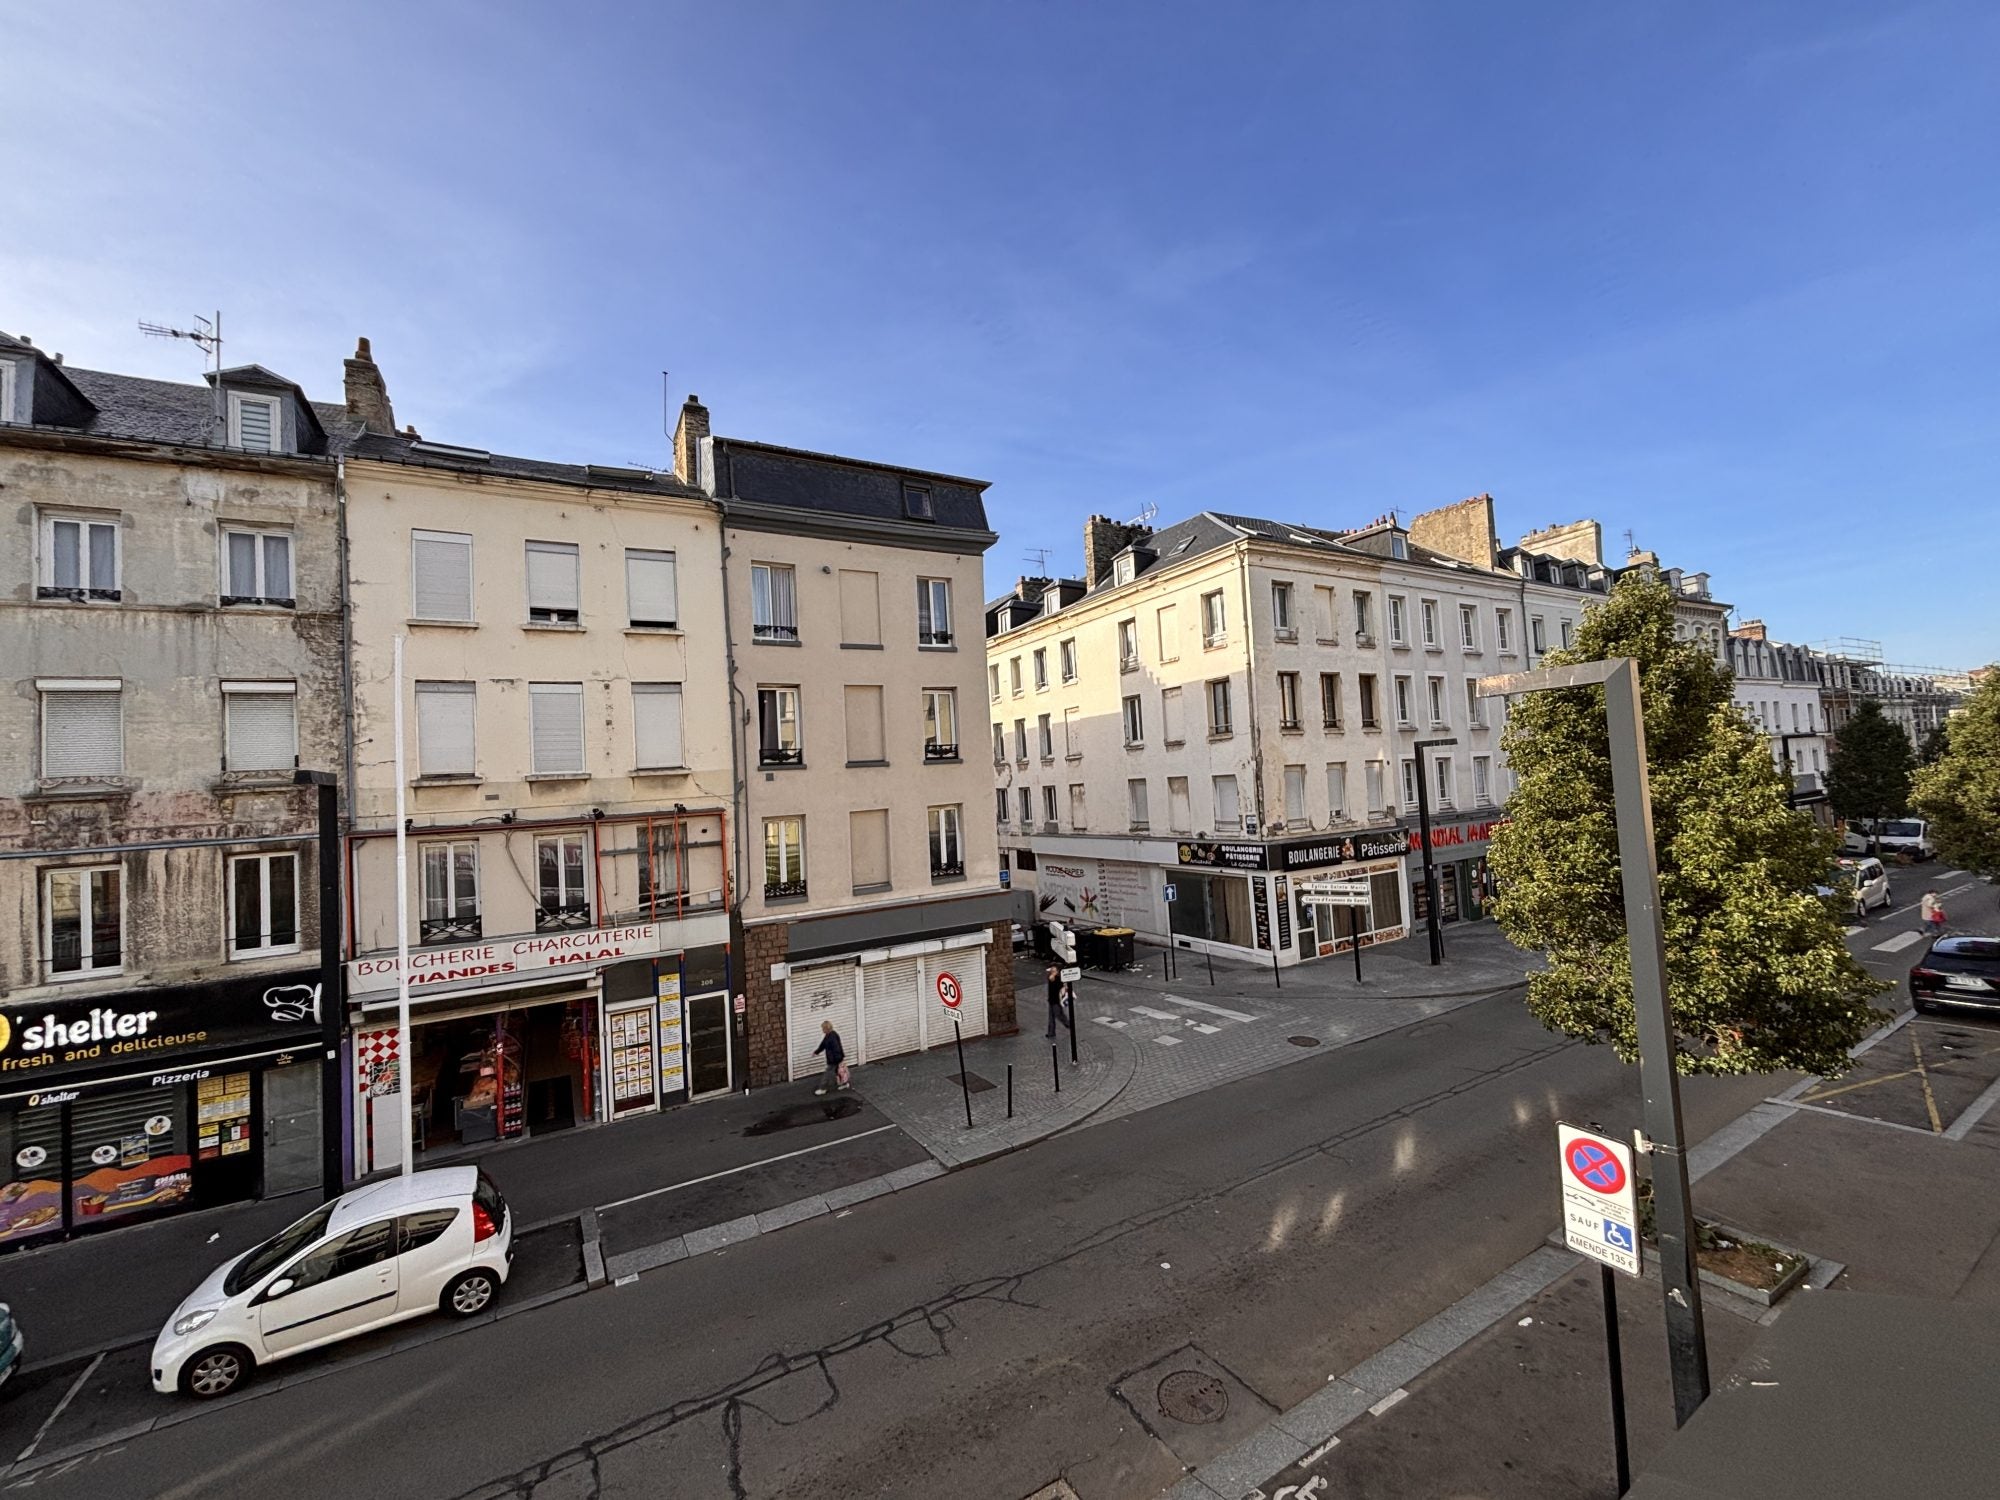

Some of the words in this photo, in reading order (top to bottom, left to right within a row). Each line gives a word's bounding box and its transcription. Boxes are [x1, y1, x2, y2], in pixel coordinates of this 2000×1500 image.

[1408, 826, 1464, 851] MNDIAL
[1221, 845, 1264, 854] BOULANGERIE
[1288, 845, 1340, 865] BOULANGERIE
[1361, 841, 1406, 857] Pâtisserie
[513, 926, 654, 955] CHARCUTERIE
[549, 947, 625, 965] HALAL
[941, 981, 957, 999] 30
[2, 1052, 54, 1071] fresh
[65, 1044, 101, 1061] and
[110, 1030, 207, 1054] delicieuse
[152, 1069, 210, 1086] Pizzeria
[1570, 1213, 1599, 1230] SAUF
[1570, 1235, 1608, 1258] AMENDE
[1610, 1252, 1626, 1266] 135
[1627, 1260, 1634, 1269] €
